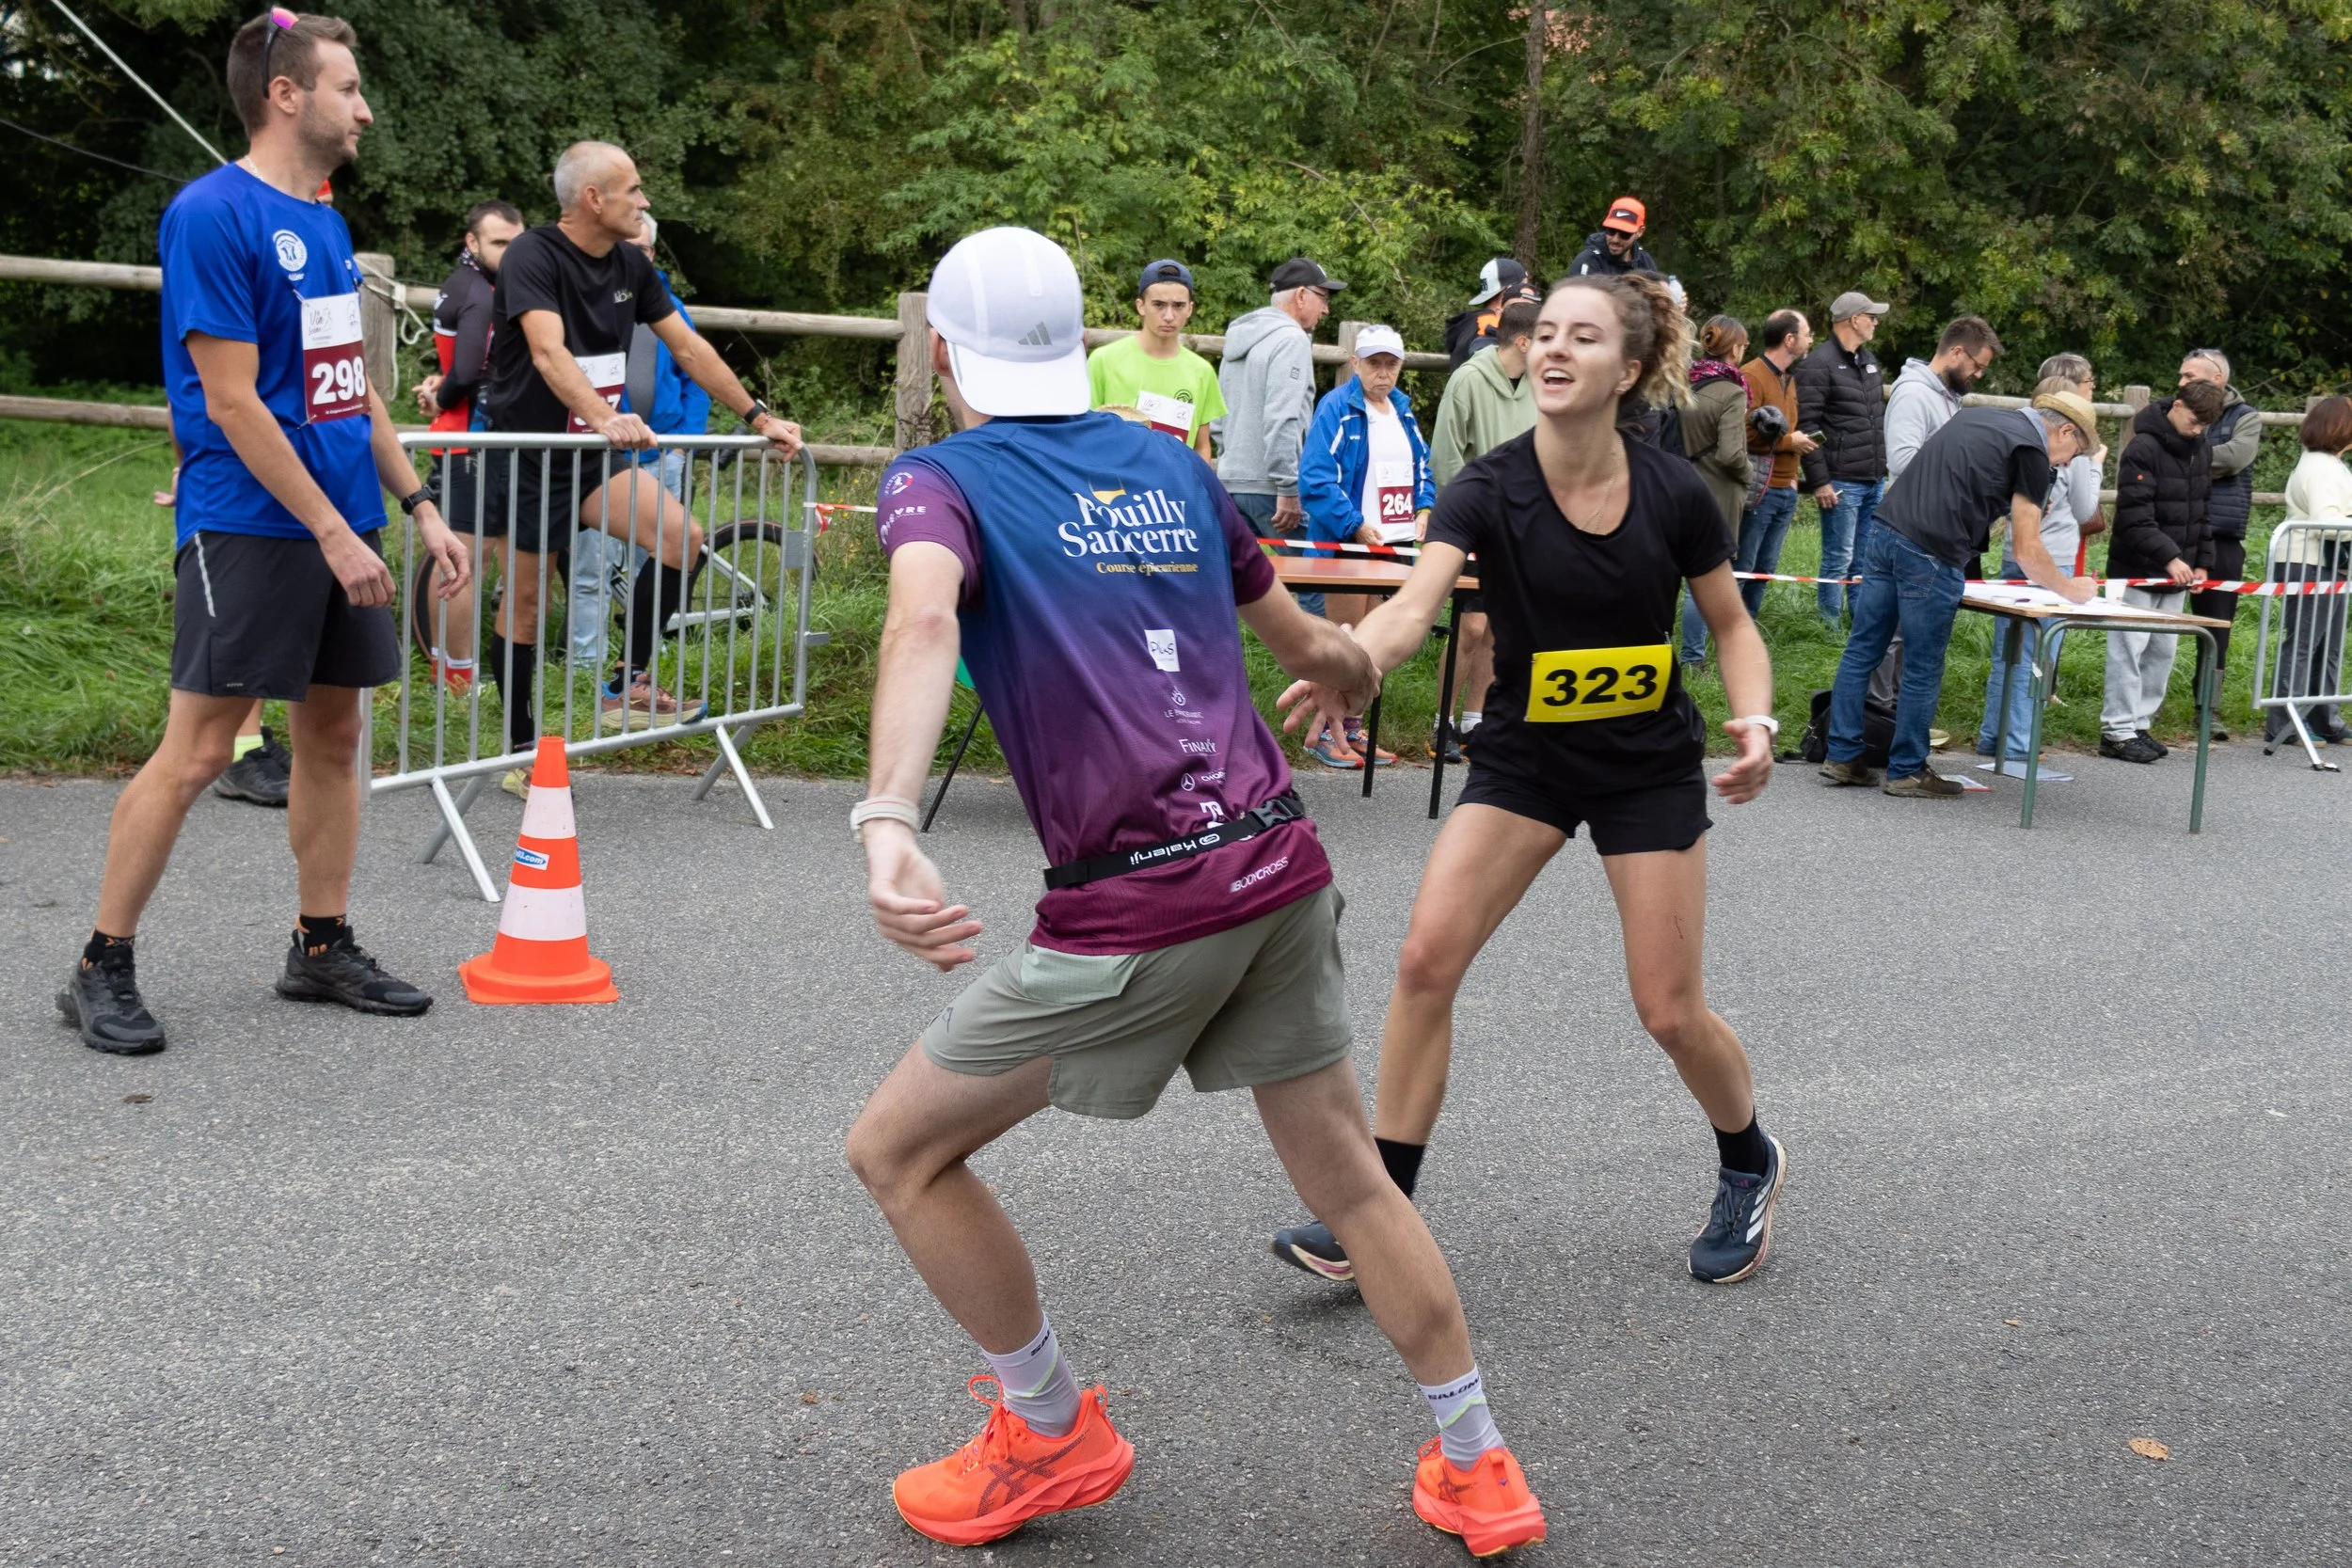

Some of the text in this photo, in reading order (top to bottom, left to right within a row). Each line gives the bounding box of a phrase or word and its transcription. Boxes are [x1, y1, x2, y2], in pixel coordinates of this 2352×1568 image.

[311, 356, 367, 405] 298
[1073, 489, 1186, 529] Pouilly
[1382, 493, 1413, 516] 264
[1058, 521, 1200, 558] Sancerre
[1096, 562, 1136, 574] Course
[1542, 664, 1658, 706] 323
[1130, 839, 1197, 865] Kalenji
[1231, 856, 1289, 892] BODYCROSS
